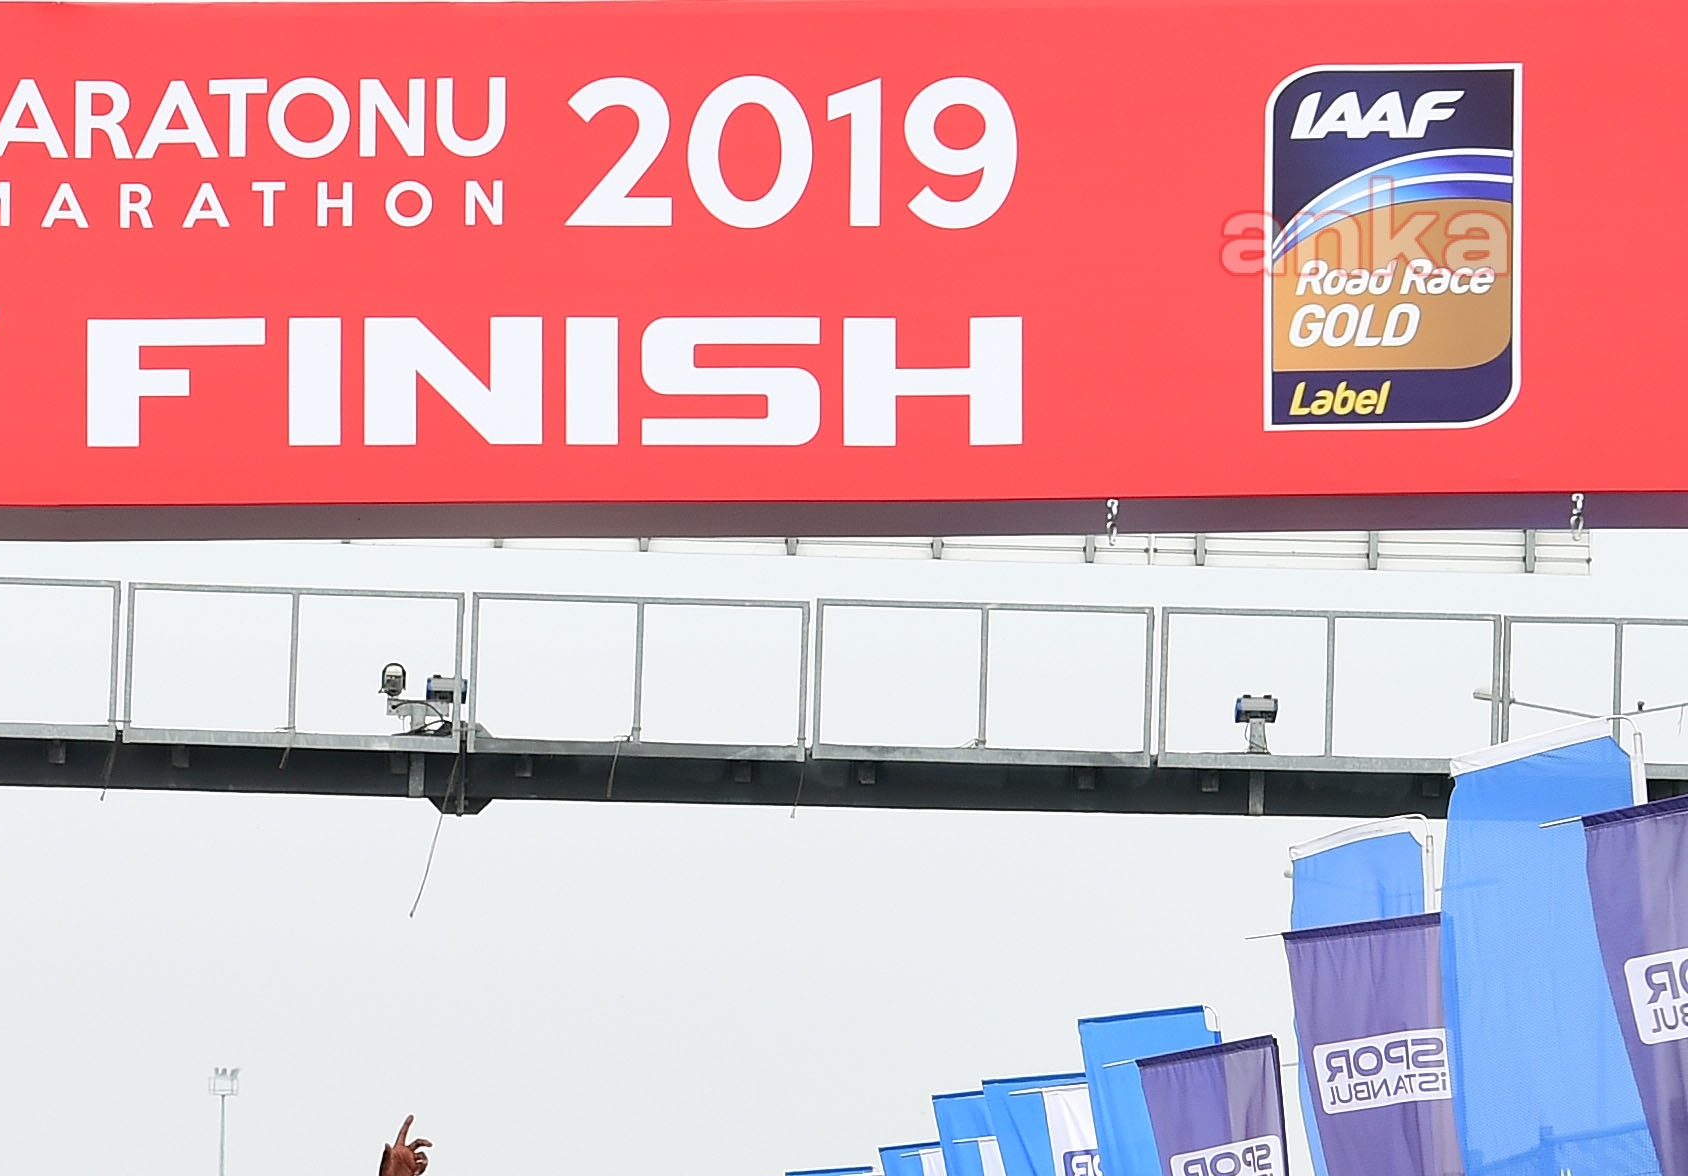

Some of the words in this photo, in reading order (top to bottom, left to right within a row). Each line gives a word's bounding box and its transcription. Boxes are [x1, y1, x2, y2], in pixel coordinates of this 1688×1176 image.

[1290, 90, 1465, 140] IAAF
[565, 75, 1019, 230] 2019
[1295, 258, 1395, 296] Road
[1400, 257, 1496, 296] Race
[1288, 302, 1421, 349] GOLD
[86, 315, 1023, 448] FINISH
[1288, 380, 1391, 417] Label
